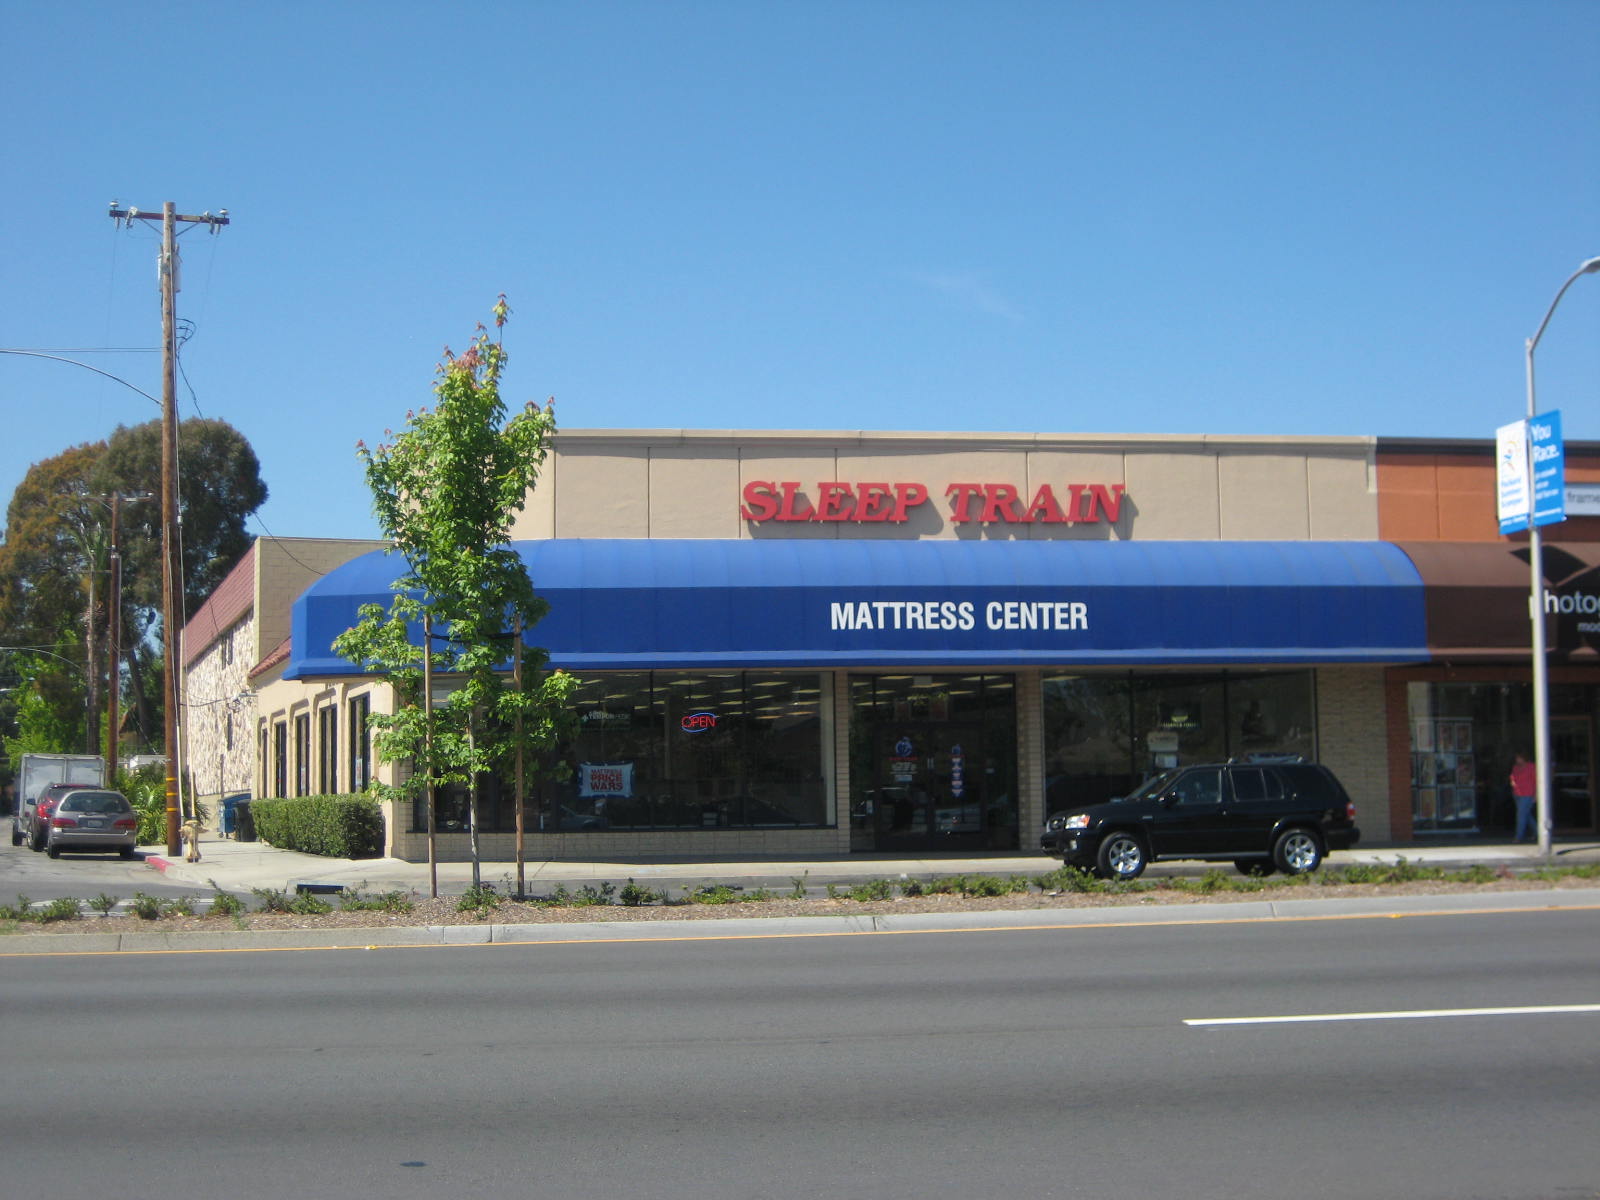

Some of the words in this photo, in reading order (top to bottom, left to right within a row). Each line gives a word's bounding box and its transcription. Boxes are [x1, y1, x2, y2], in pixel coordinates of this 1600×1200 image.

[1531, 424, 1551, 442] You
[740, 480, 928, 522] SLEEP
[944, 483, 1125, 523] TRAIN
[830, 601, 975, 630] MATTRESS
[986, 601, 1089, 630] CENTER
[1528, 589, 1600, 619] hoto
[681, 715, 717, 728] OPEN
[590, 782, 623, 791] WARS
